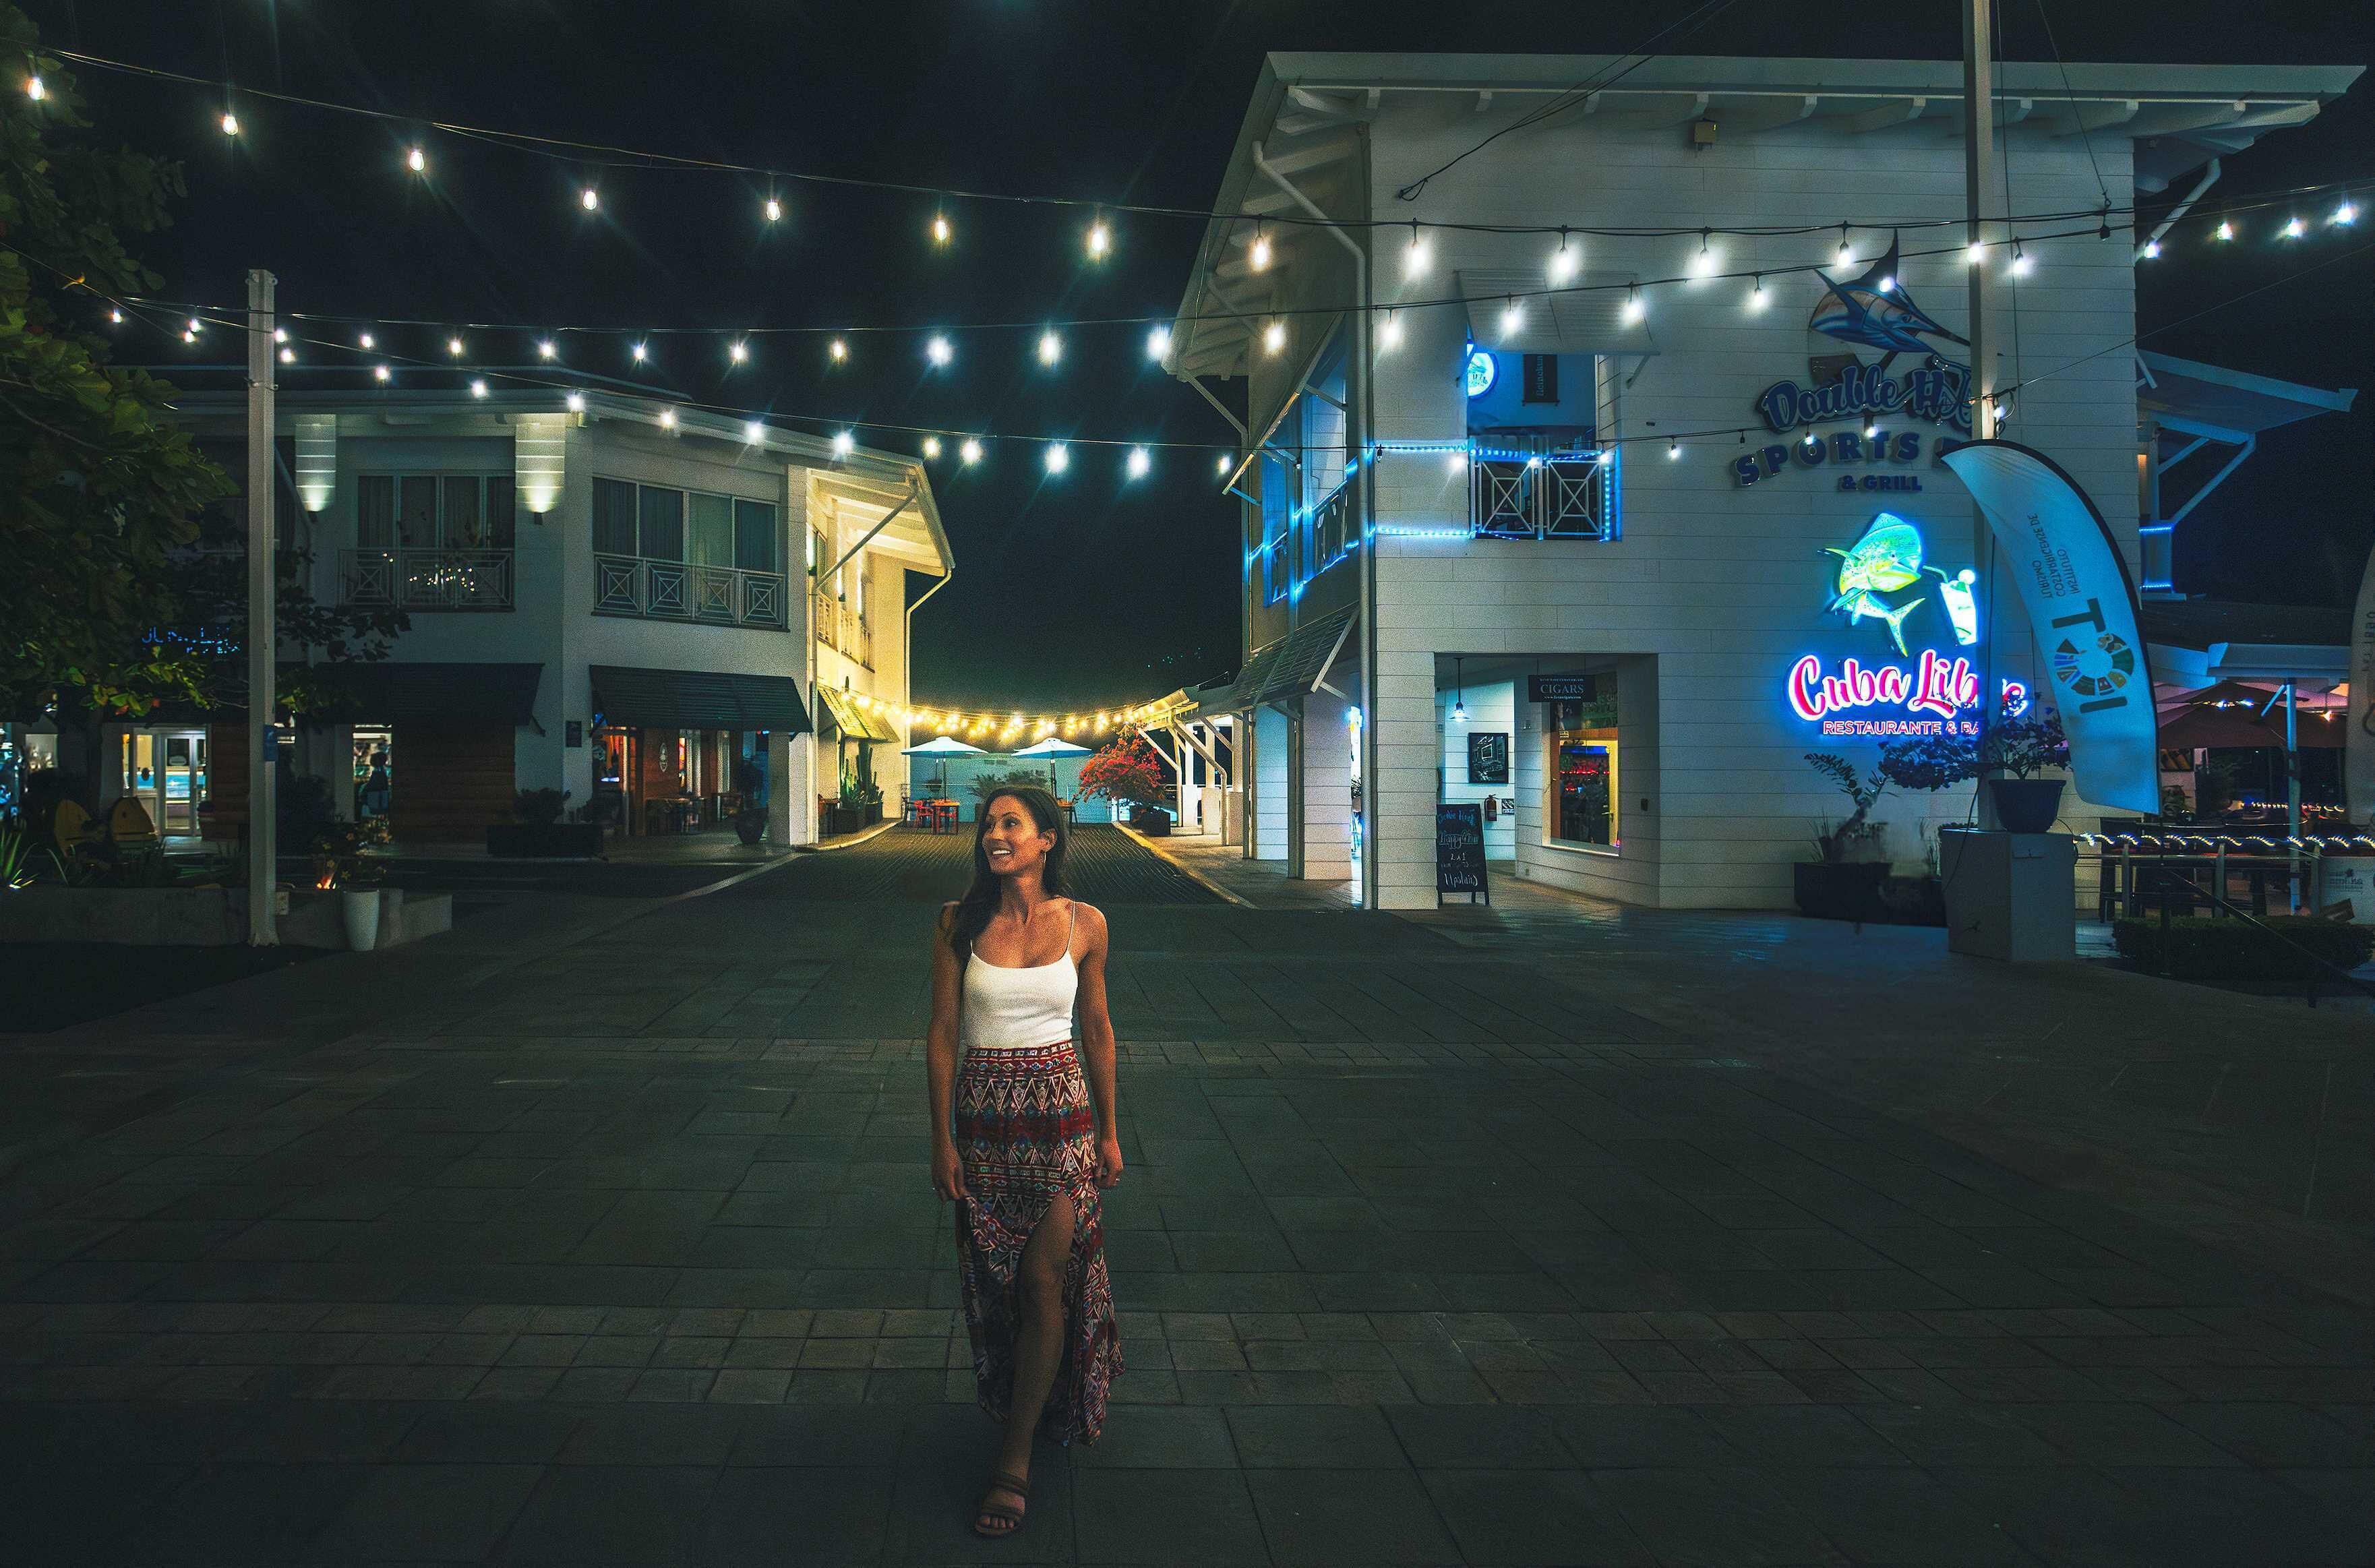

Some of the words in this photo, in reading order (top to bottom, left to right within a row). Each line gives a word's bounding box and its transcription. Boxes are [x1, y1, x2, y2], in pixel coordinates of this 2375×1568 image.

[1758, 364, 1900, 433] Double
[1733, 431, 1920, 486] SPORTS
[1839, 475, 1858, 491] &
[1860, 475, 1923, 491] GRILL
[1540, 684, 1584, 694] CIGARS
[1788, 655, 1911, 721] Cuba
[1907, 649, 2028, 719] Libe
[1824, 721, 1942, 735] RESTAURANTE
[1945, 721, 1958, 735] &
